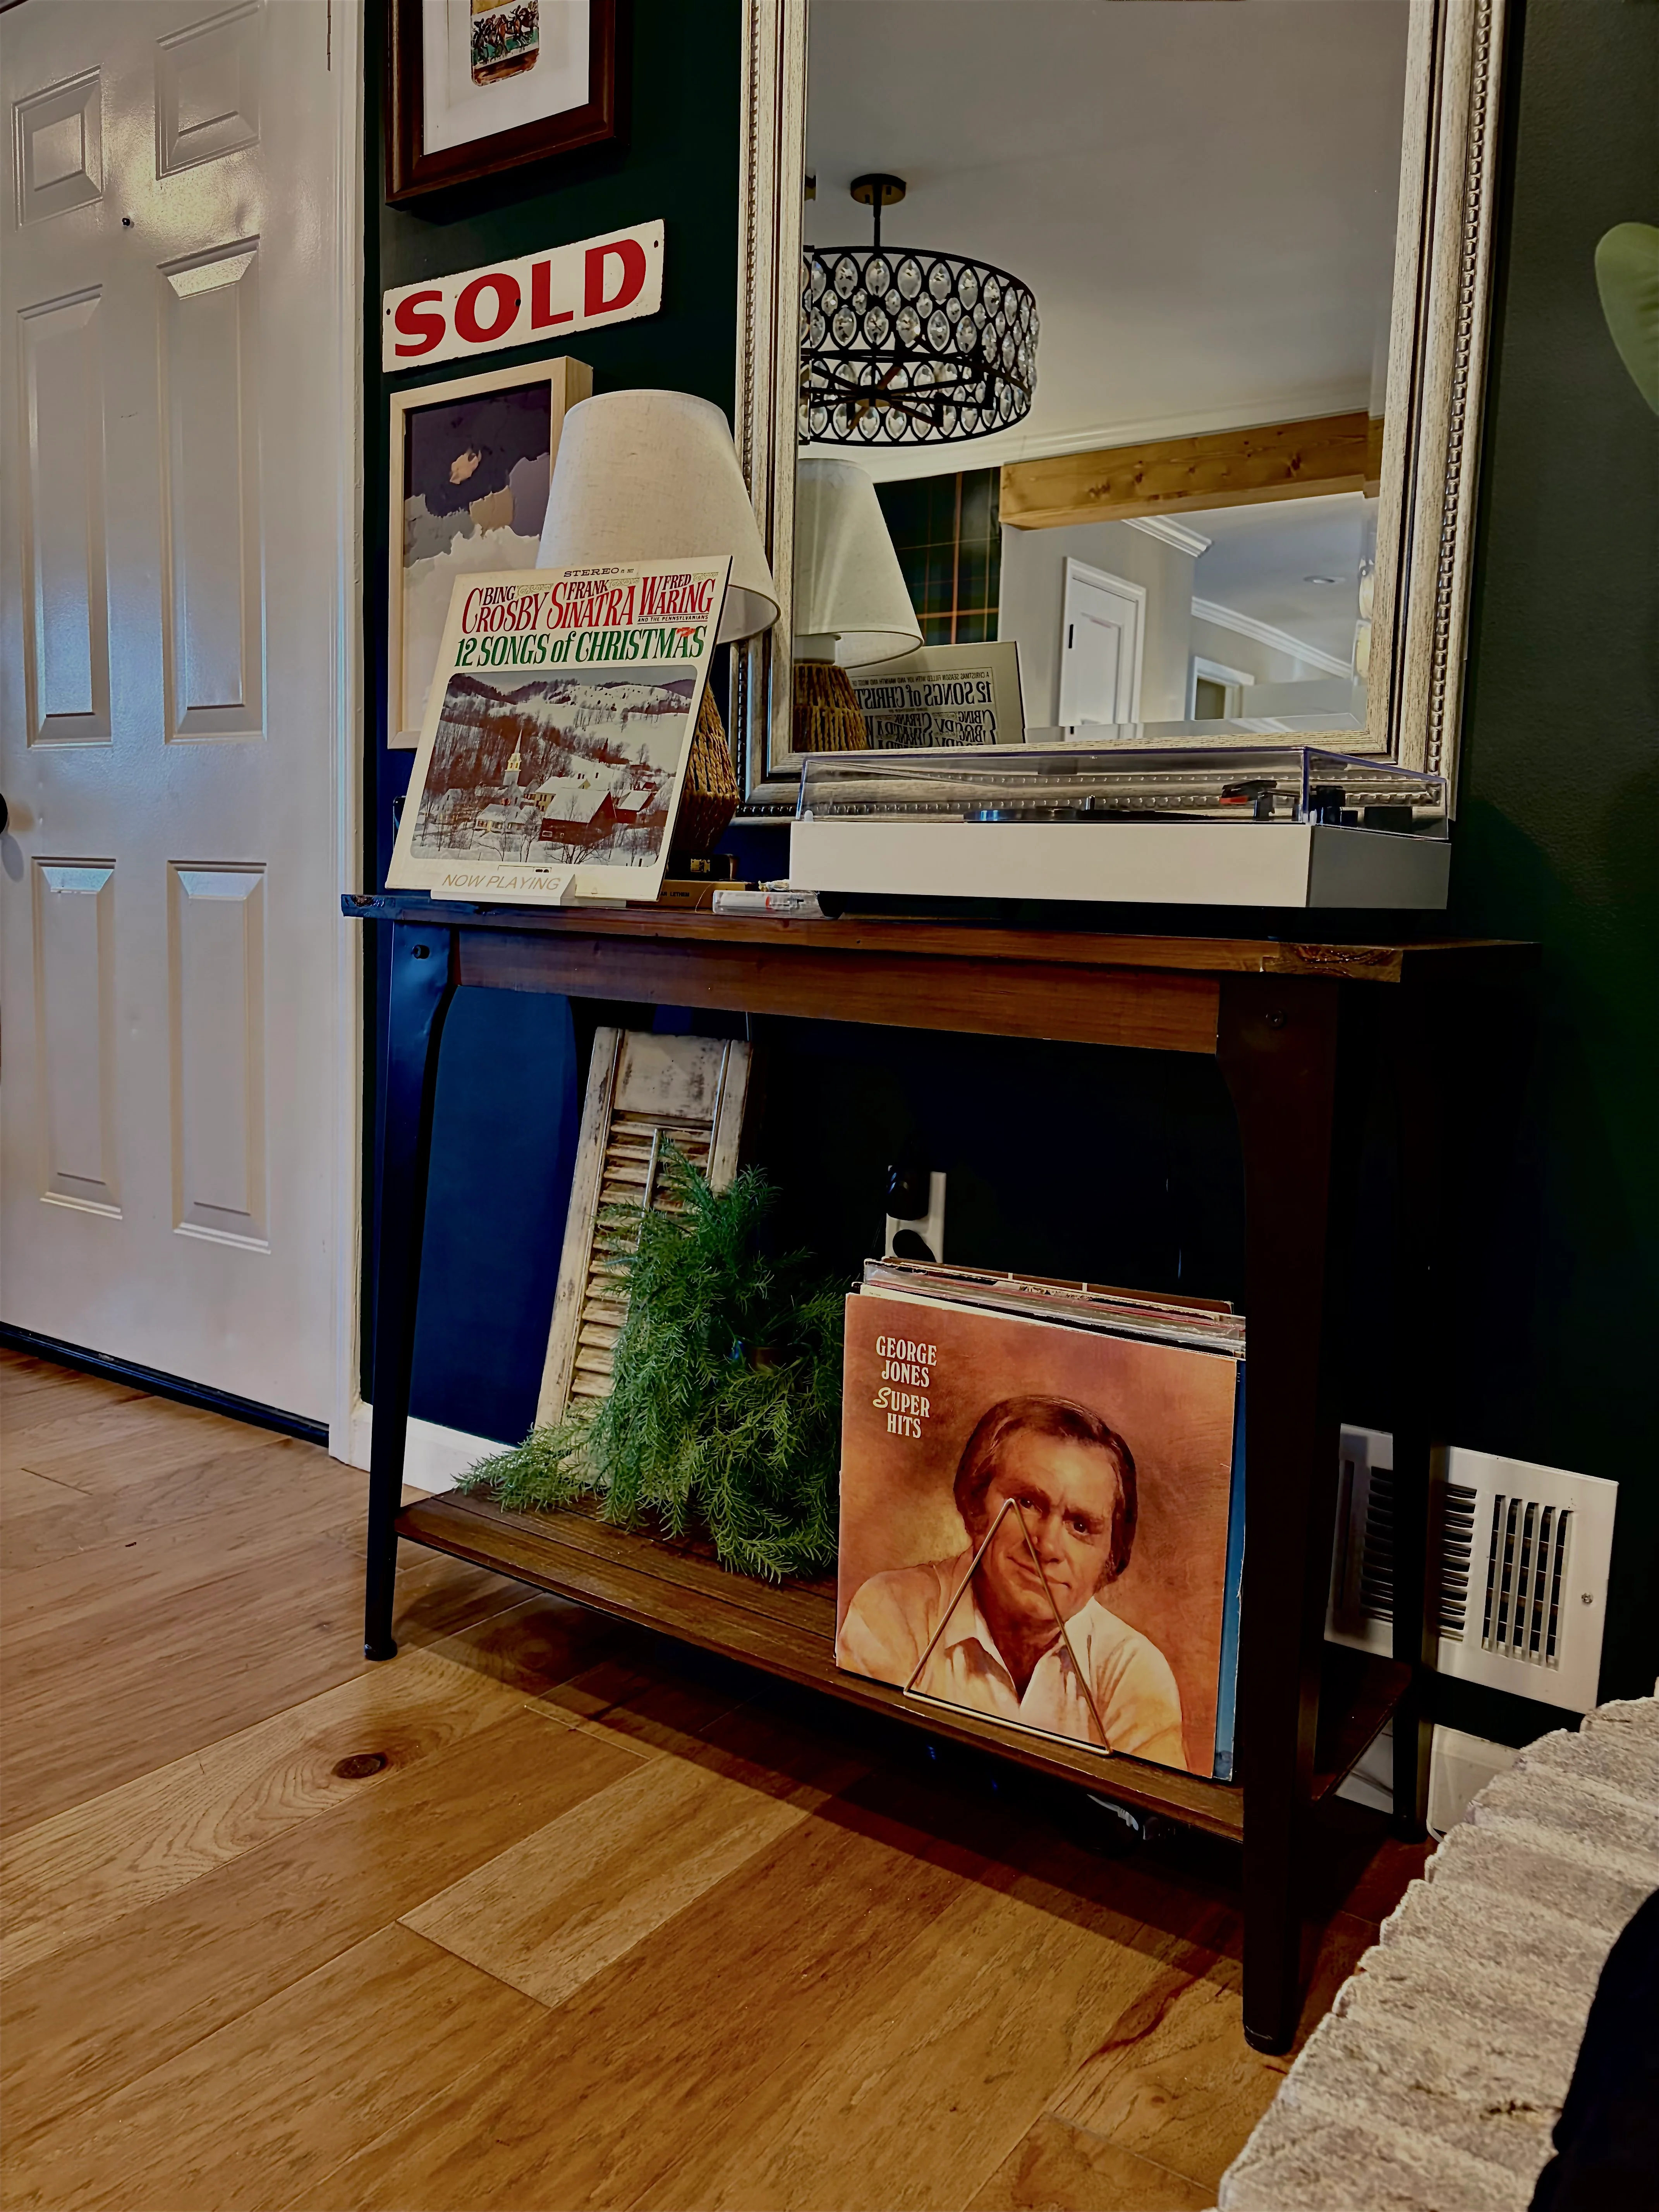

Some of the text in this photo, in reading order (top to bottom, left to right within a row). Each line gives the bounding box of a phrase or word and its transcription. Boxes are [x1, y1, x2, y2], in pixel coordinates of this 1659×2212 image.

[395, 239, 646, 357] SOLD
[564, 567, 619, 577] STEREO
[462, 585, 550, 634] BING CROSBY
[546, 579, 636, 629] FRANK SINATRA
[639, 574, 716, 615] FRED WARING
[454, 625, 708, 667] 12 SONGS of CHRISTMAS
[442, 874, 561, 890] NOW PLAYING
[876, 1336, 937, 1366] GEORGE
[881, 1360, 929, 1388] JONES
[872, 1387, 929, 1418] SUPER
[887, 1413, 921, 1438] HITS
